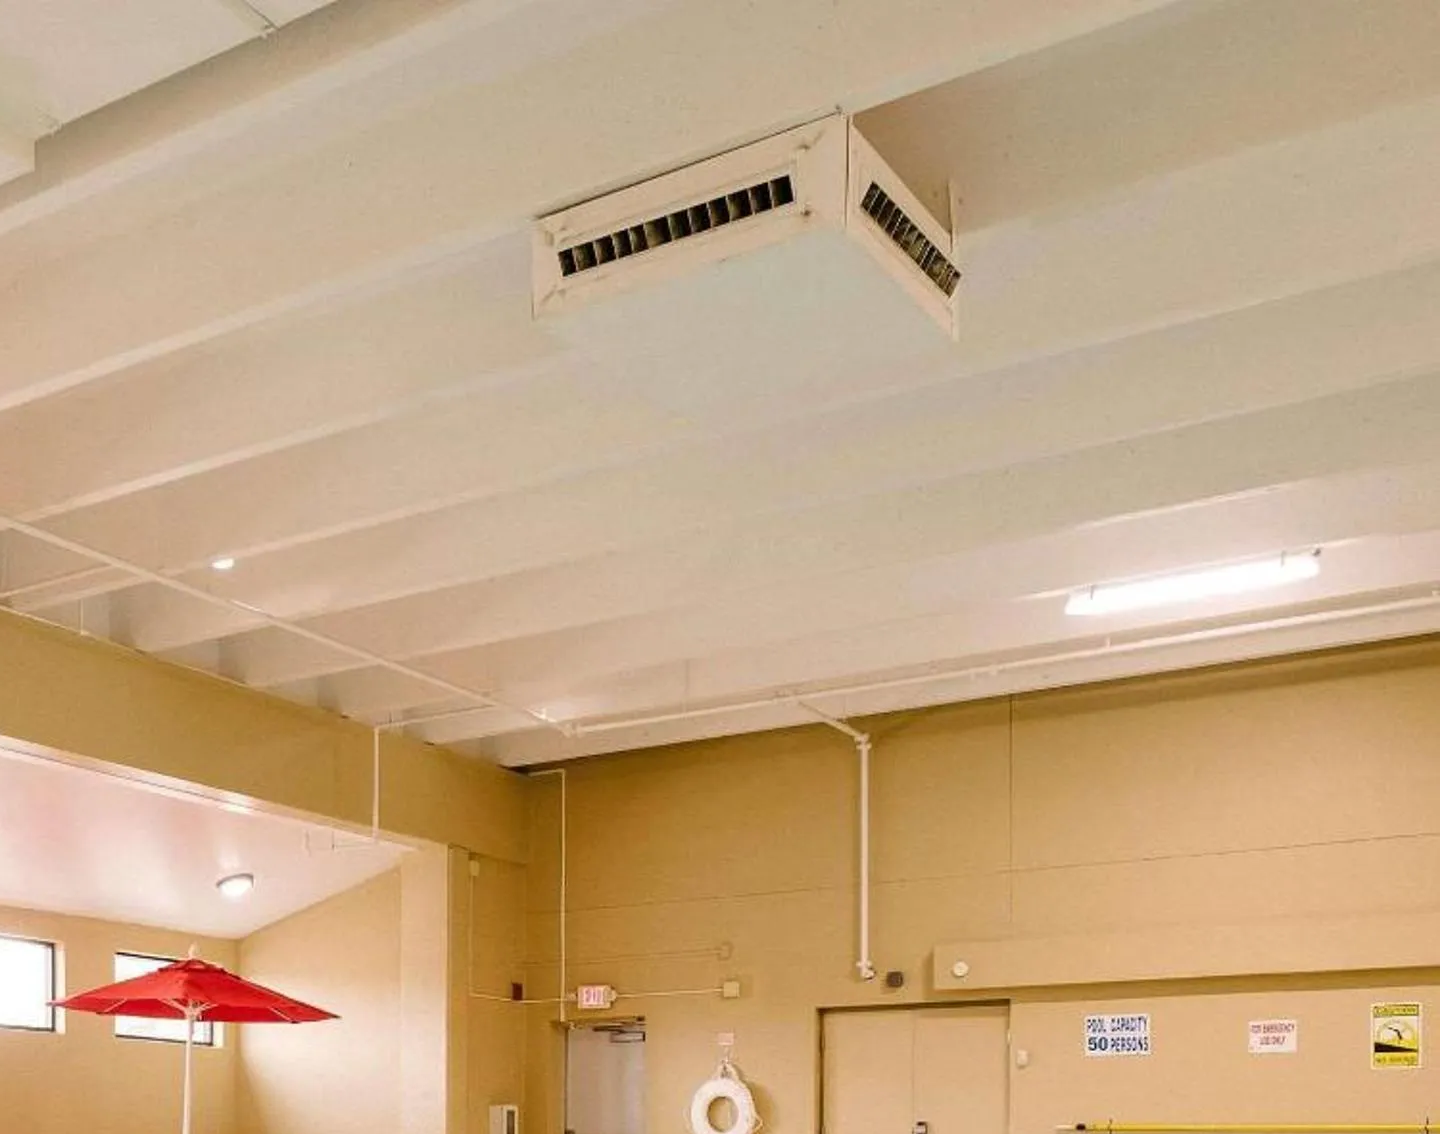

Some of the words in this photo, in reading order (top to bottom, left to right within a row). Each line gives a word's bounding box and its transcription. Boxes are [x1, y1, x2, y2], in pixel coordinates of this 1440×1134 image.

[1087, 1018, 1106, 1033] POOL
[1111, 1016, 1147, 1032] CAPACITY
[1088, 1036, 1108, 1051] 50
[1110, 1036, 1148, 1052] PERSONS
